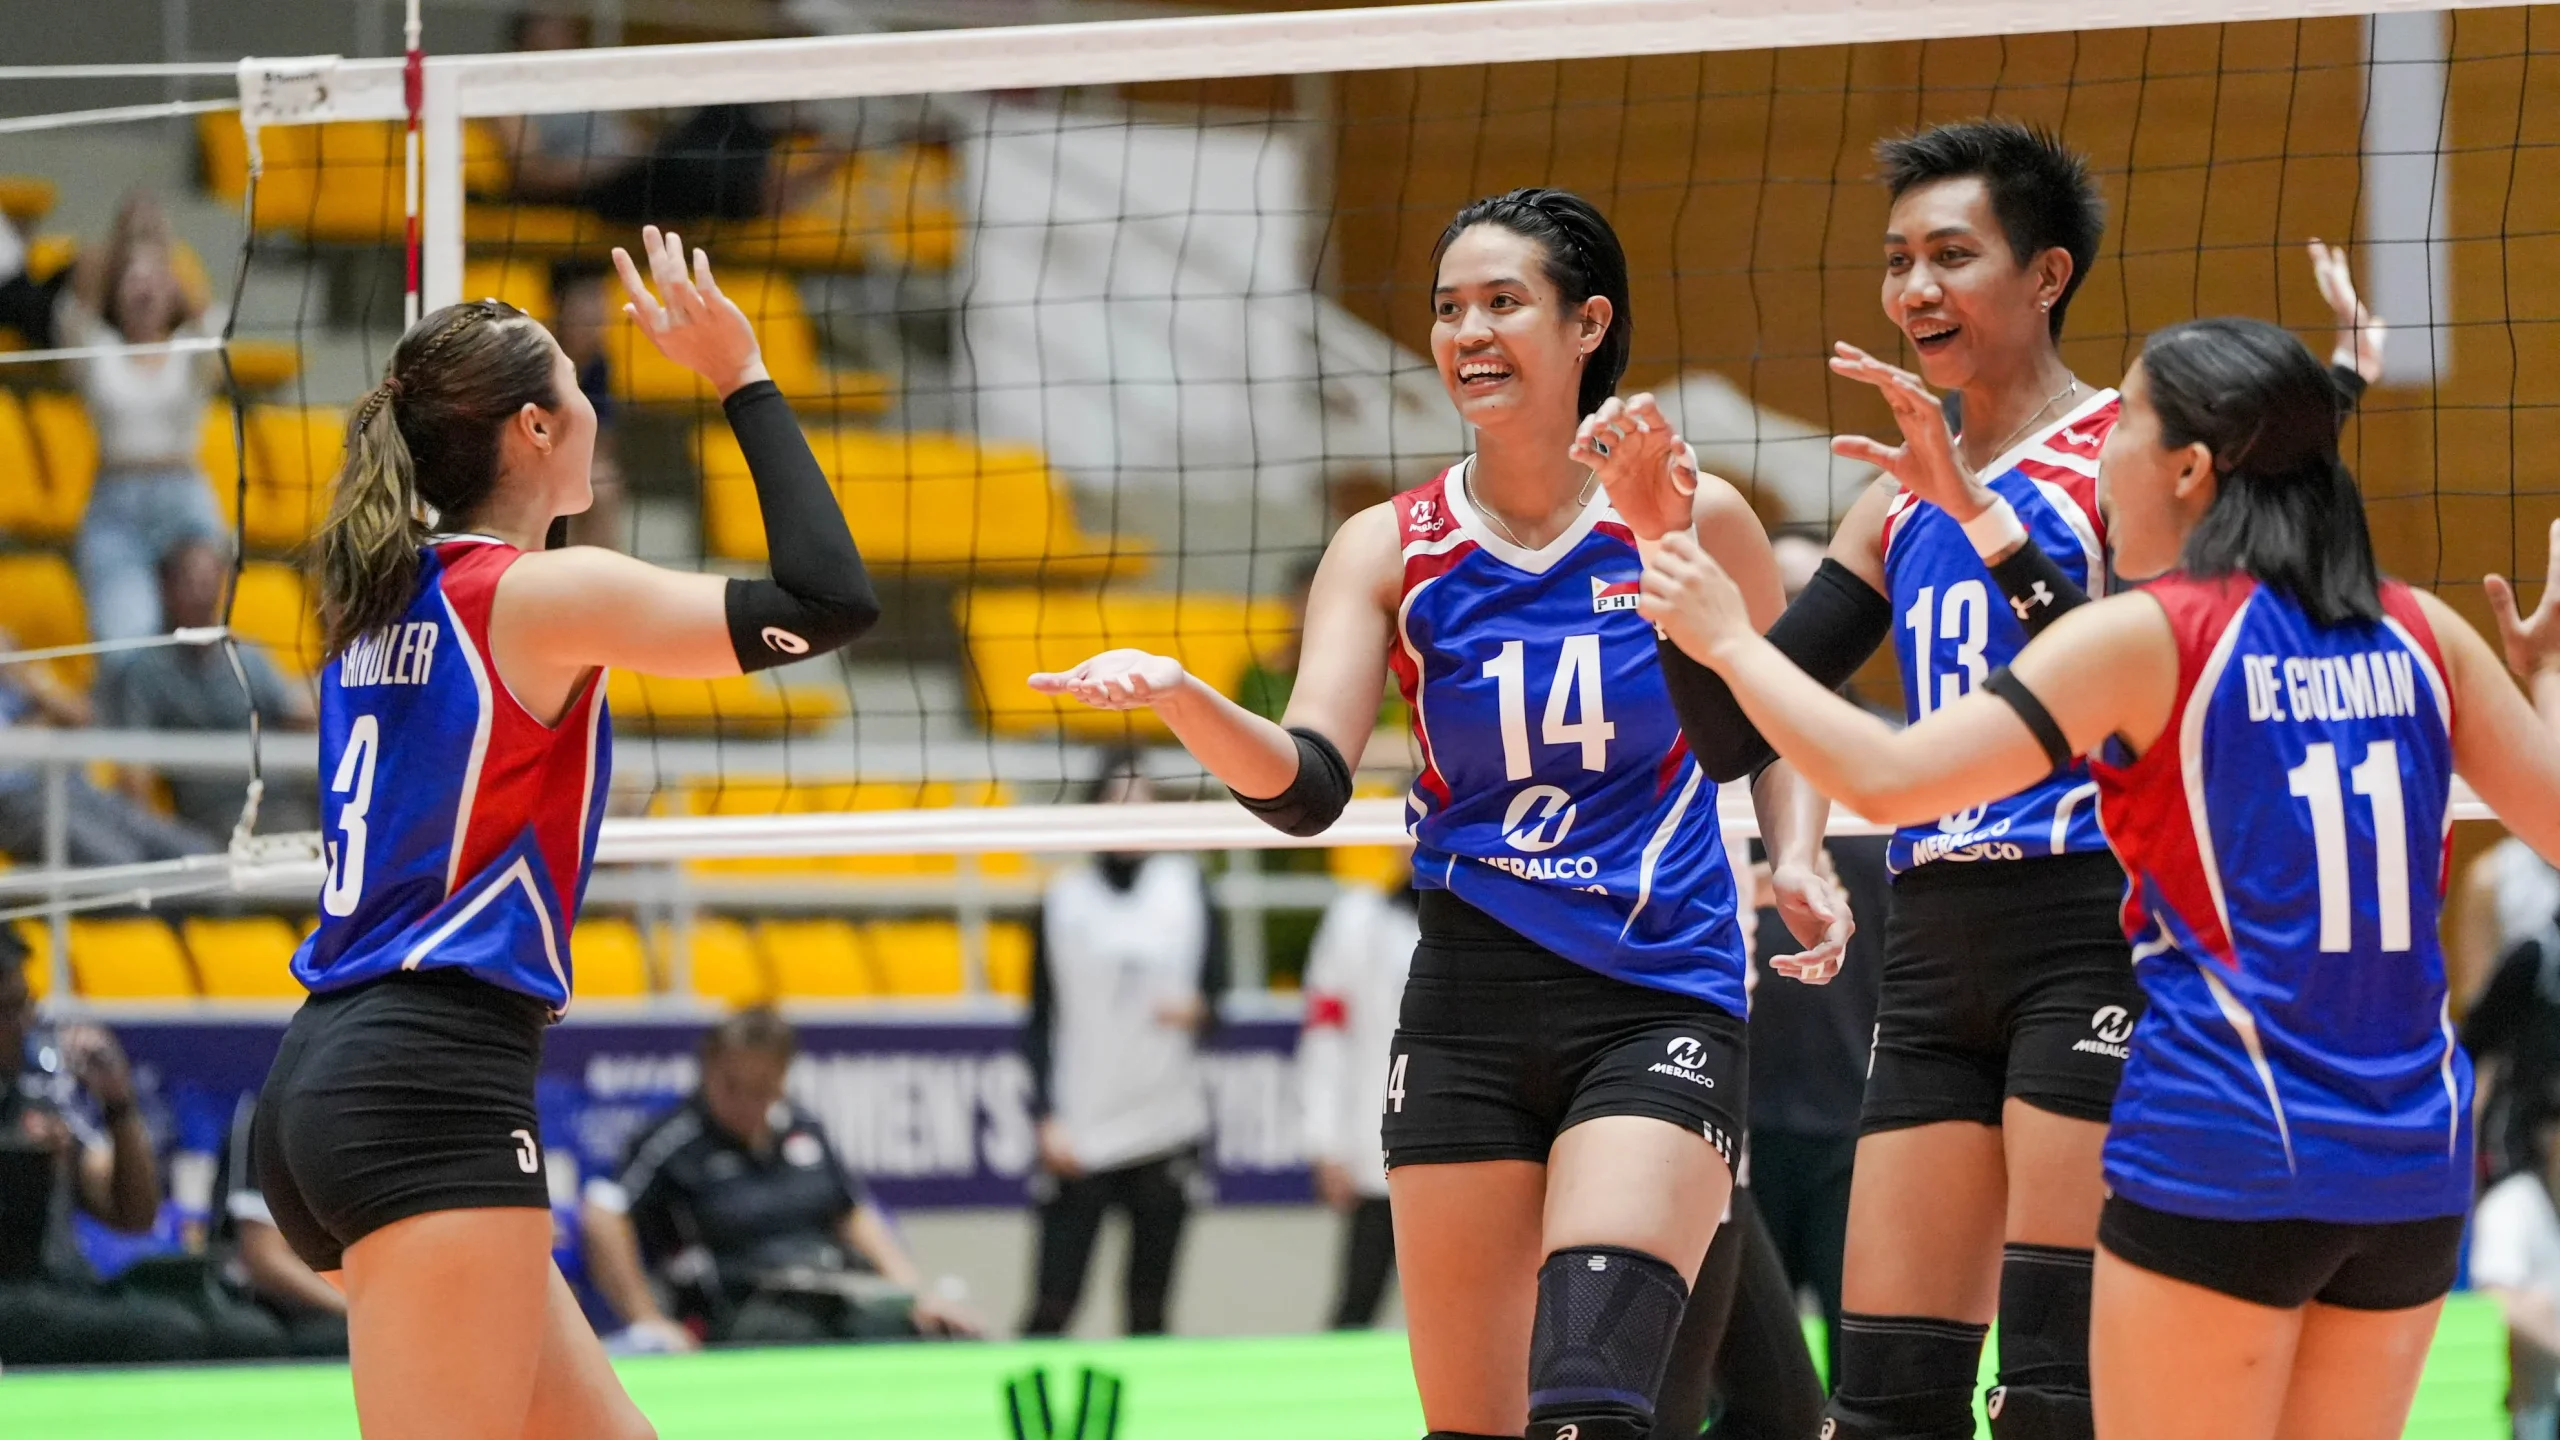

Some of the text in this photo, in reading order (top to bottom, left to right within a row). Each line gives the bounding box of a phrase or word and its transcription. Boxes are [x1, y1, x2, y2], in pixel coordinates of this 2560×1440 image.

[1597, 595, 1636, 610] PHI
[1905, 579, 1990, 722] 13
[1482, 633, 1616, 782] 14
[2242, 651, 2417, 723] DE GUZMAN
[323, 714, 379, 917] 3
[2288, 739, 2412, 953] 11
[1647, 1062, 1715, 1089] MERALCO
[2071, 1038, 2132, 1060] MERALC
